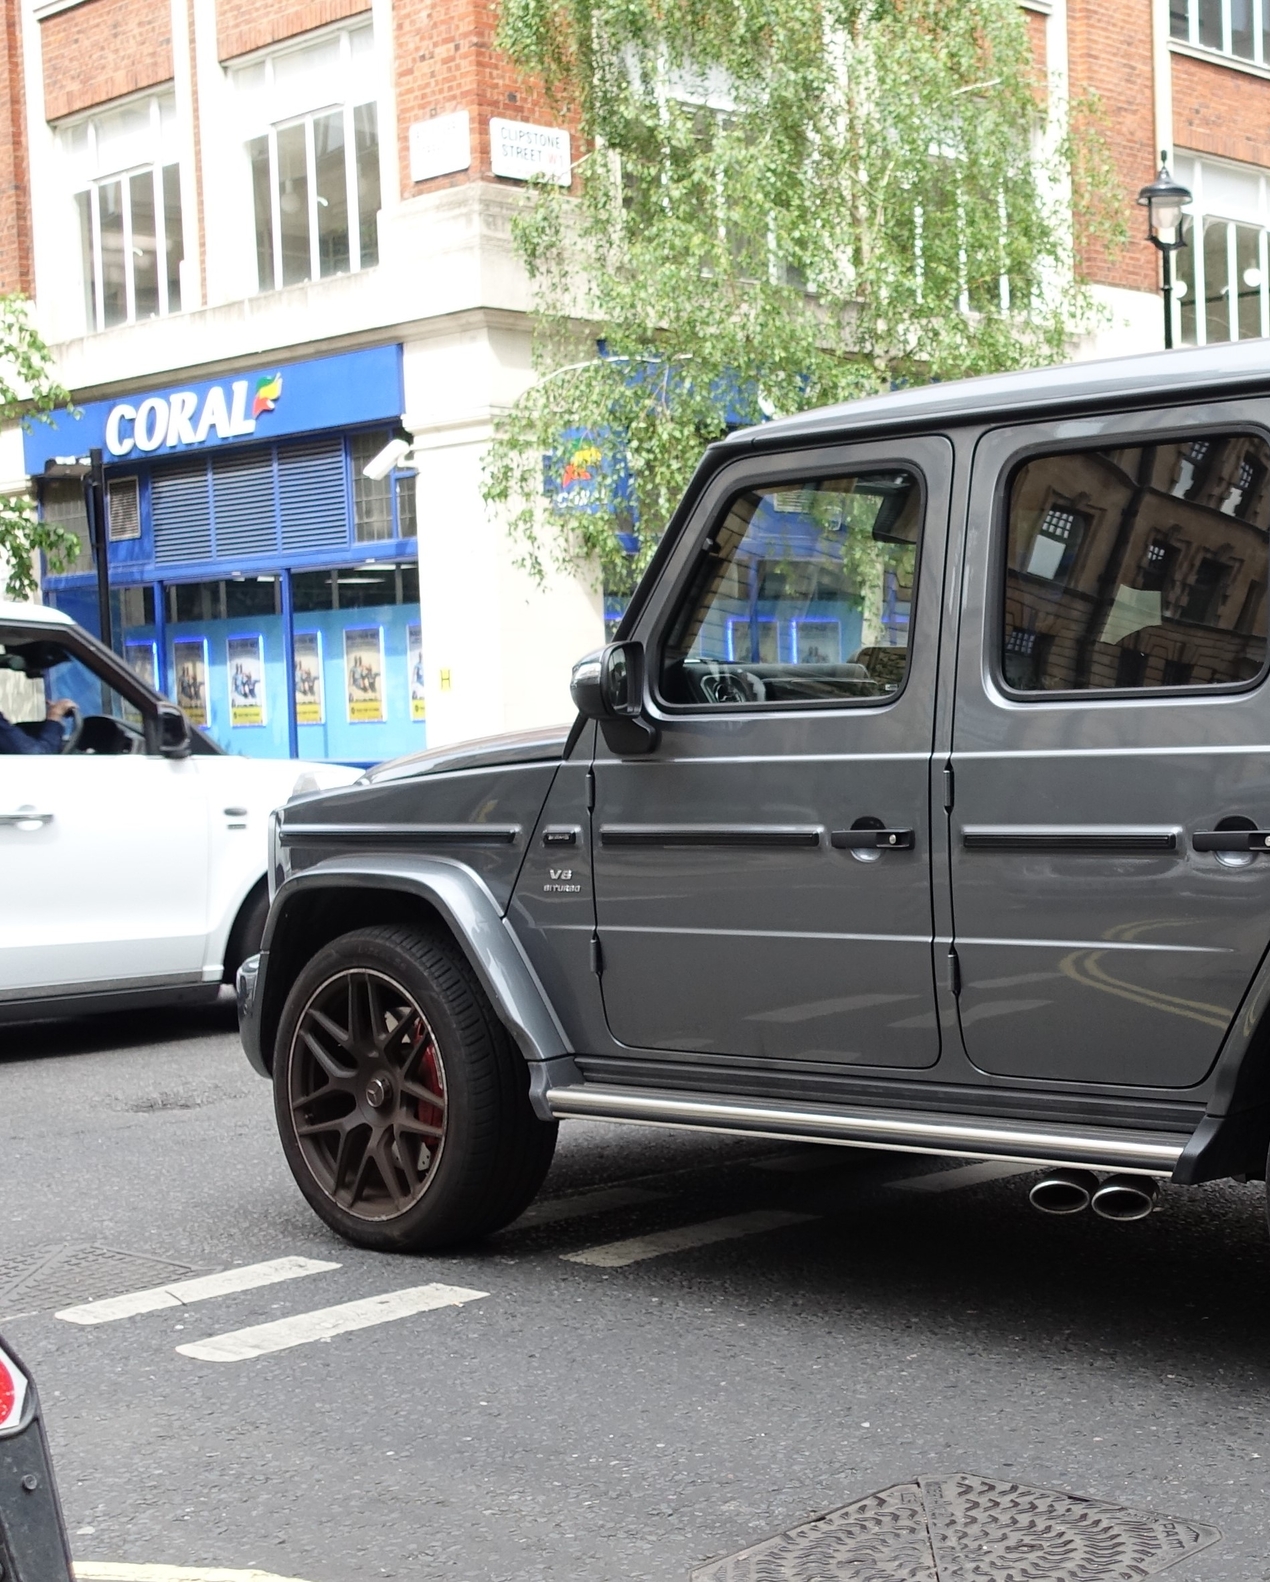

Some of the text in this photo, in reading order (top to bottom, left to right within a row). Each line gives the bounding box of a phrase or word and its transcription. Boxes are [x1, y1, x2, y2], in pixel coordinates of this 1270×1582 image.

[500, 126, 561, 149] CLIPSTONE
[501, 143, 542, 162] STREET
[105, 377, 256, 456] CORAL
[440, 669, 451, 690] H
[549, 868, 573, 880] V8
